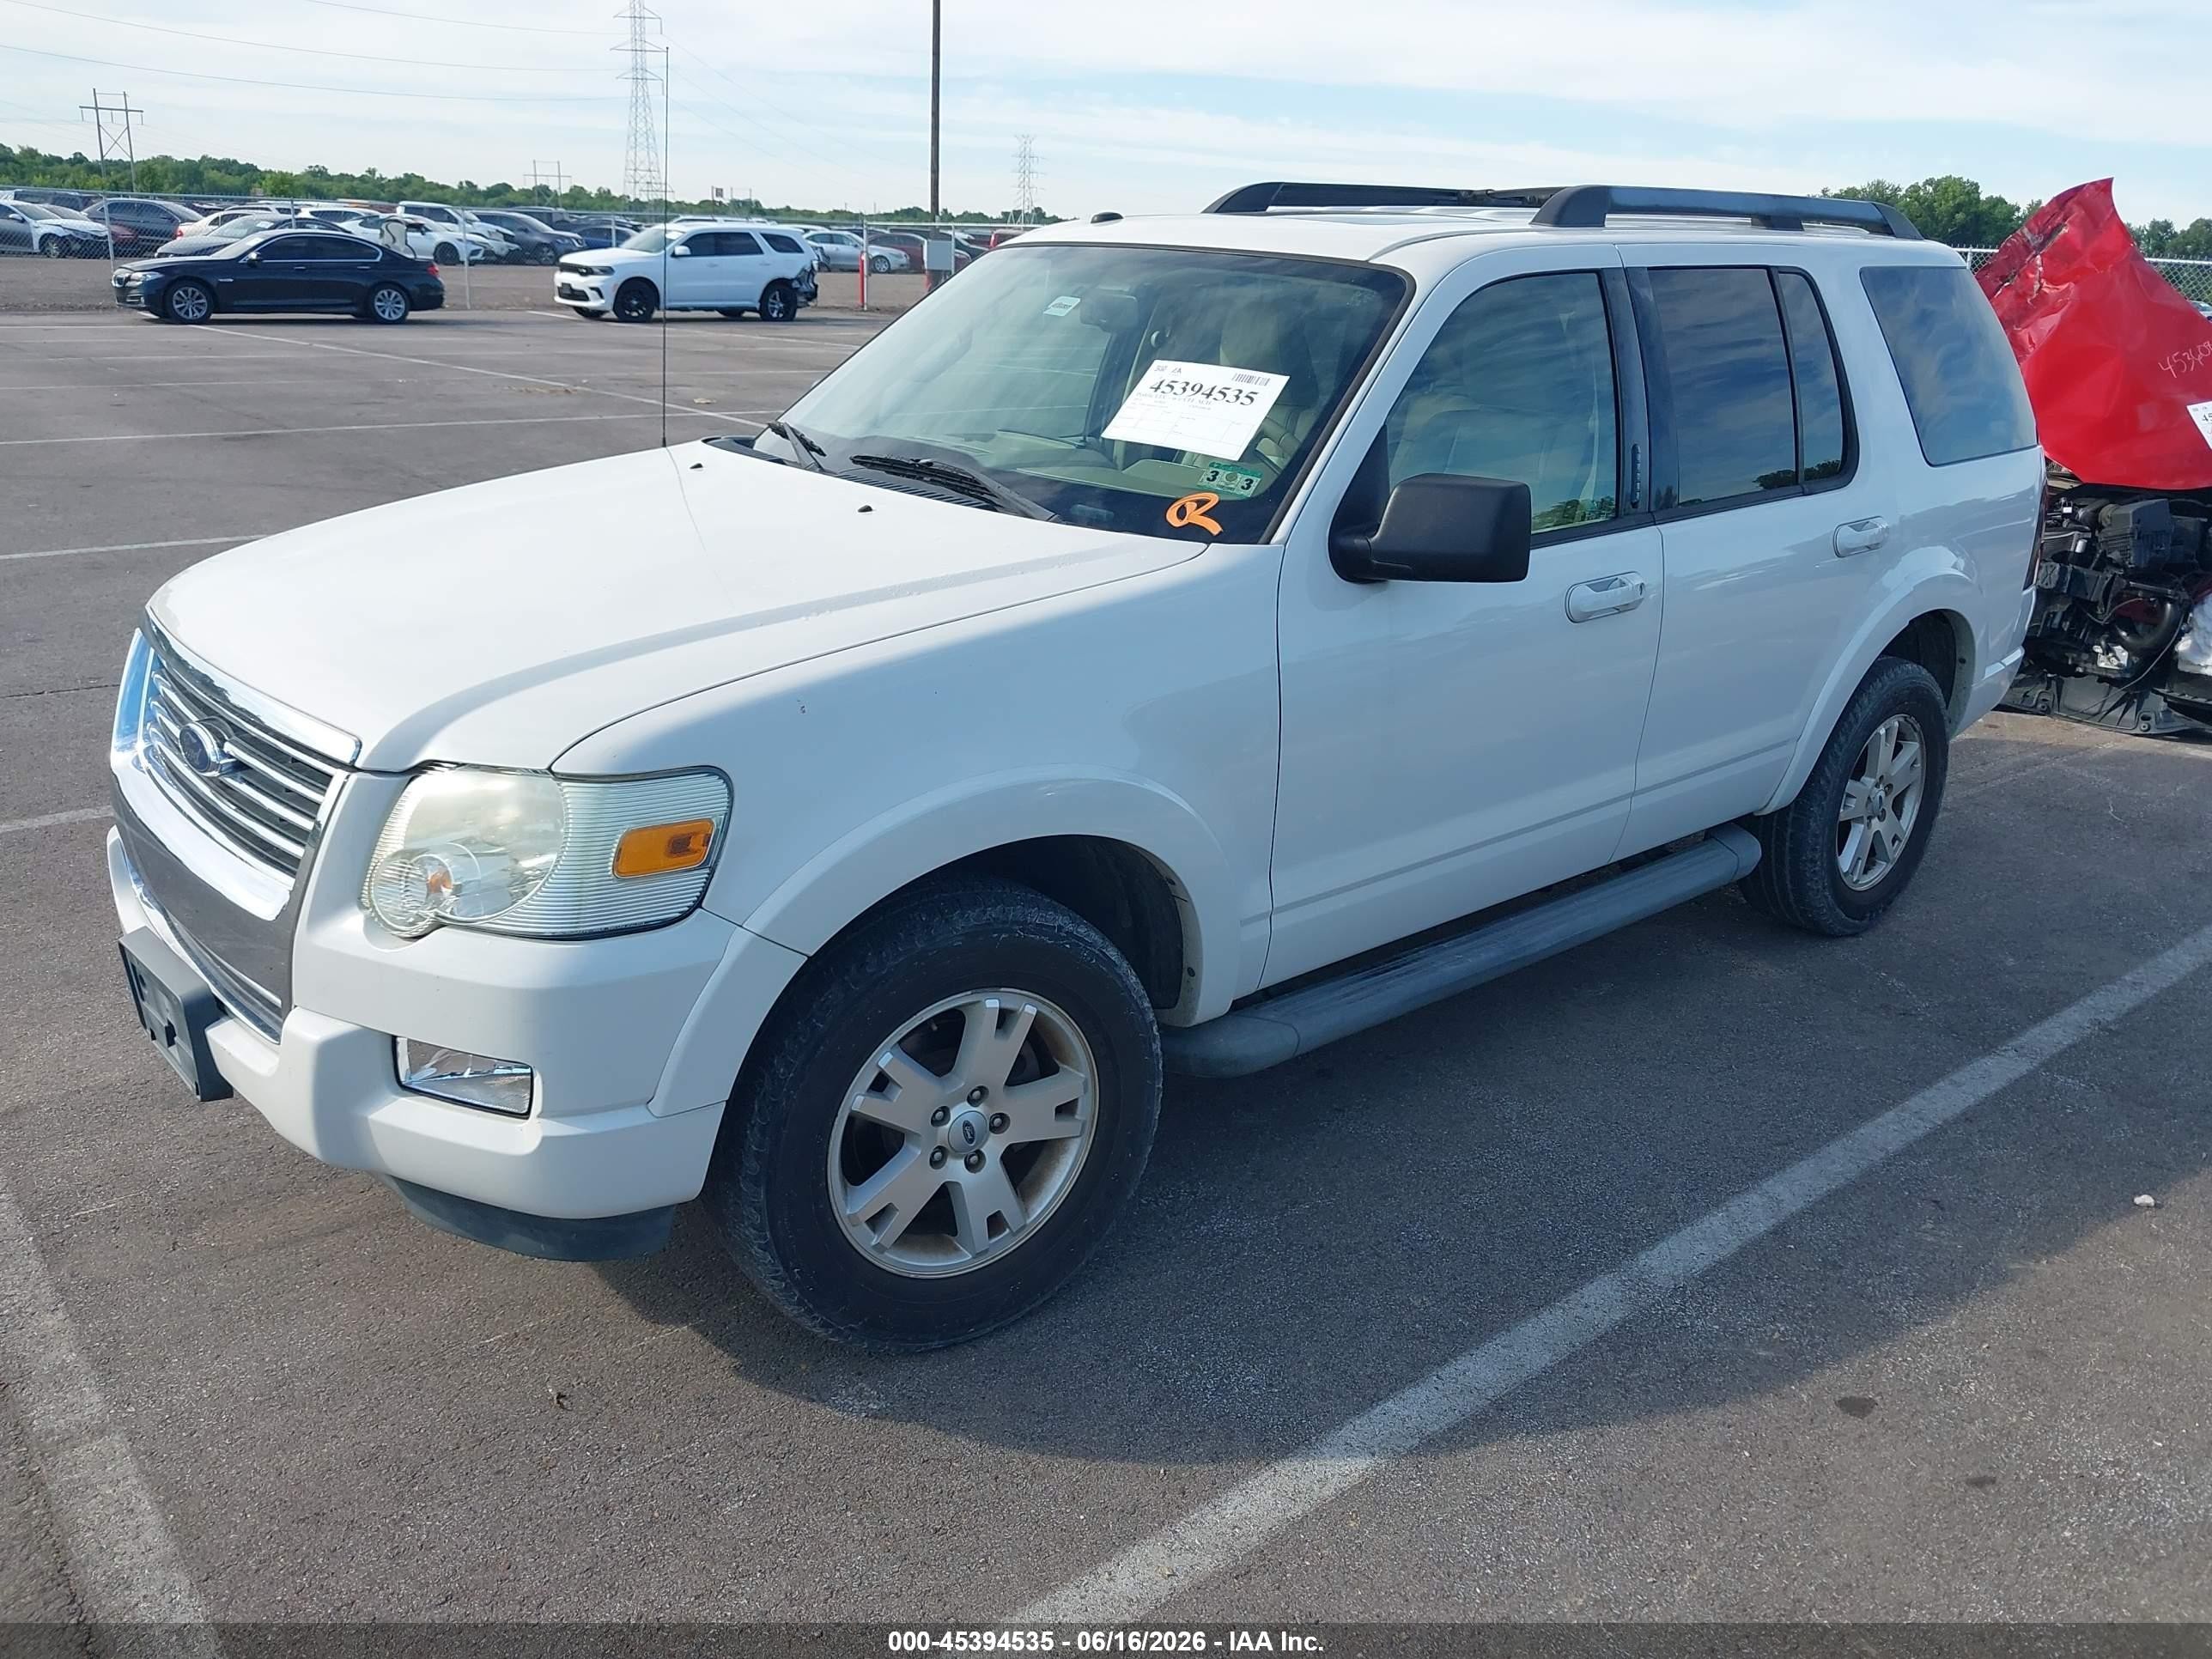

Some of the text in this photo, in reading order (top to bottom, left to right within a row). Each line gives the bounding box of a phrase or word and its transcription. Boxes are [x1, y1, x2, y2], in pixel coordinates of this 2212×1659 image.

[1149, 379, 1261, 406] 45394535
[1206, 470, 1219, 483] 3
[1241, 477, 1255, 491] 3
